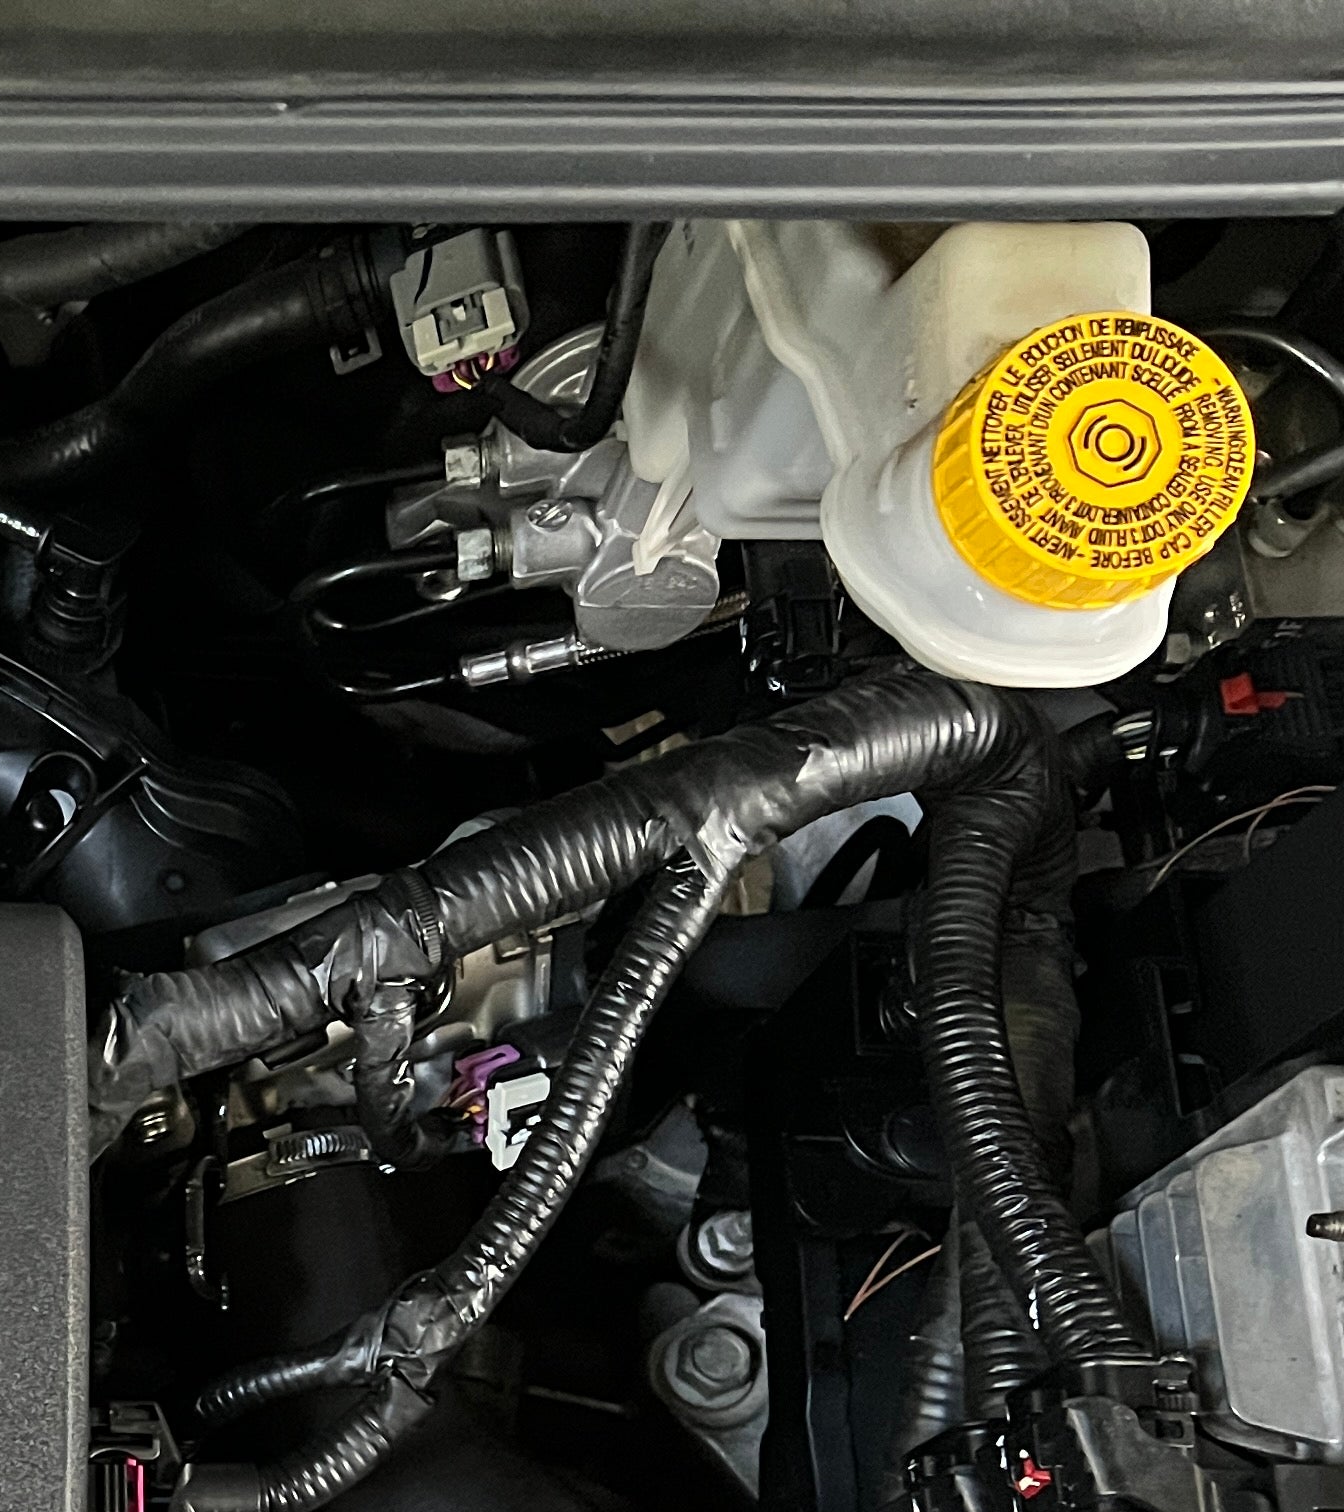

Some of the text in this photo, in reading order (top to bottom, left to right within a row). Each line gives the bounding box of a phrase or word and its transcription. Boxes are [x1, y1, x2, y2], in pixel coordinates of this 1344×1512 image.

[1053, 340, 1127, 371] SEULEMENT
[981, 390, 1012, 464] NETTOYER
[1001, 365, 1026, 388] LE
[1020, 322, 1084, 366] BOUCHON
[1089, 318, 1111, 337] DE
[1114, 318, 1200, 362] REMPLISSAGE
[1011, 364, 1056, 415] UTILISER
[1049, 361, 1128, 400] CONTENANT
[1032, 399, 1059, 430] D'UN
[1172, 403, 1201, 438] FROM
[1182, 442, 1201, 452] A
[1027, 432, 1069, 502] PROVENANT
[1166, 455, 1201, 498] SEALED
[1021, 486, 1044, 508] DE
[1064, 495, 1078, 511] 3
[1188, 474, 1218, 506] USE
[1039, 507, 1086, 540] AVANT
[1165, 501, 1197, 532] ONLY
[1188, 492, 1233, 538] FILLER
[1088, 527, 1127, 547] FLUID
[1131, 528, 1140, 545] 3
[1142, 520, 1165, 544] DOT
[1160, 531, 1192, 560] CAP
[1090, 548, 1154, 569] BEFORE
